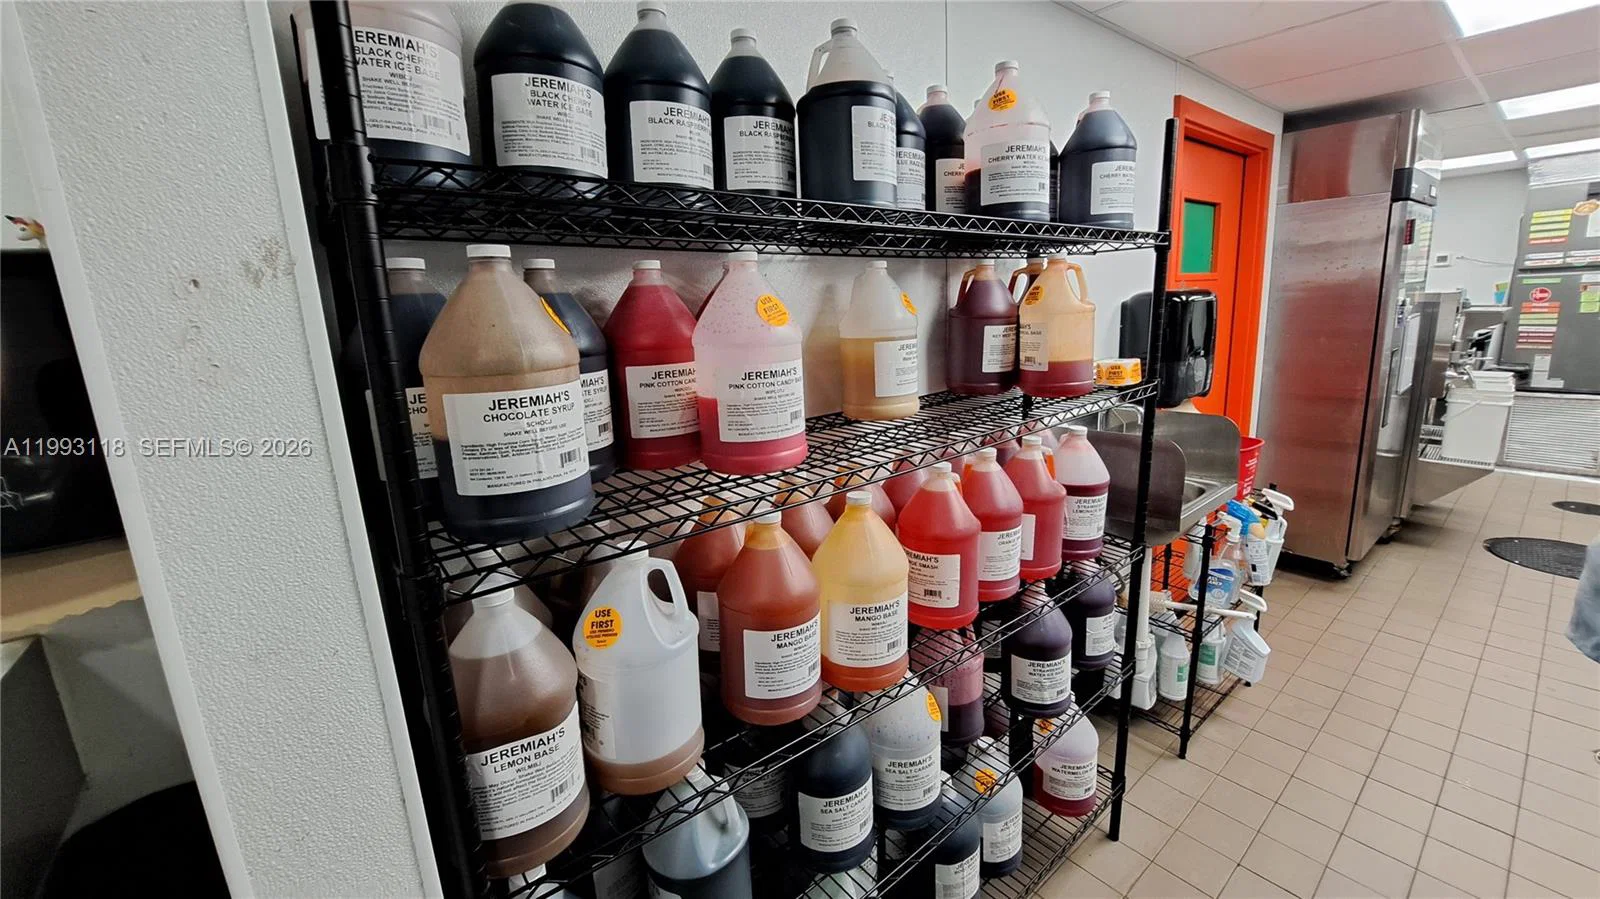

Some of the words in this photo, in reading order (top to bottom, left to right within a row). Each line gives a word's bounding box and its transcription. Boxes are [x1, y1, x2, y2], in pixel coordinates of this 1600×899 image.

[354, 30, 438, 58] EREMIAH'S
[354, 46, 392, 59] BLACK
[525, 77, 592, 99] JEREMIAH'S
[530, 90, 560, 100] BLACK
[527, 98, 559, 108] WATER
[648, 117, 675, 125] BLACK
[1005, 144, 1047, 153] JEREMIAH'S
[988, 155, 1014, 163] CHERRY
[651, 368, 696, 380] JEREMIAH
[741, 367, 797, 381] JEREMIAH'S
[581, 376, 604, 388] MIAH'S
[657, 380, 683, 388] COTTON
[746, 381, 775, 389] COTTON
[488, 390, 570, 411] JEREMIAH'S
[483, 409, 550, 423] CHOCOLATE
[551, 402, 575, 414] SYRUP
[594, 609, 612, 618] USE
[849, 600, 900, 614] JEREMIAH'S
[855, 614, 882, 622] MANGO
[883, 609, 898, 619] BASE
[591, 620, 614, 629] FIRST
[771, 619, 818, 642] JEREMIAH'S
[776, 637, 803, 649] MANGO
[804, 629, 817, 641] BASE
[1027, 659, 1066, 668] JEREMIAH'S
[480, 727, 566, 767] JEREMIAH'S
[493, 755, 531, 774] LEMON
[534, 743, 560, 760] BASE
[887, 755, 933, 769] JEREMIAH'S
[823, 786, 868, 808] JEREMIAH'S
[834, 805, 849, 813] SALT
